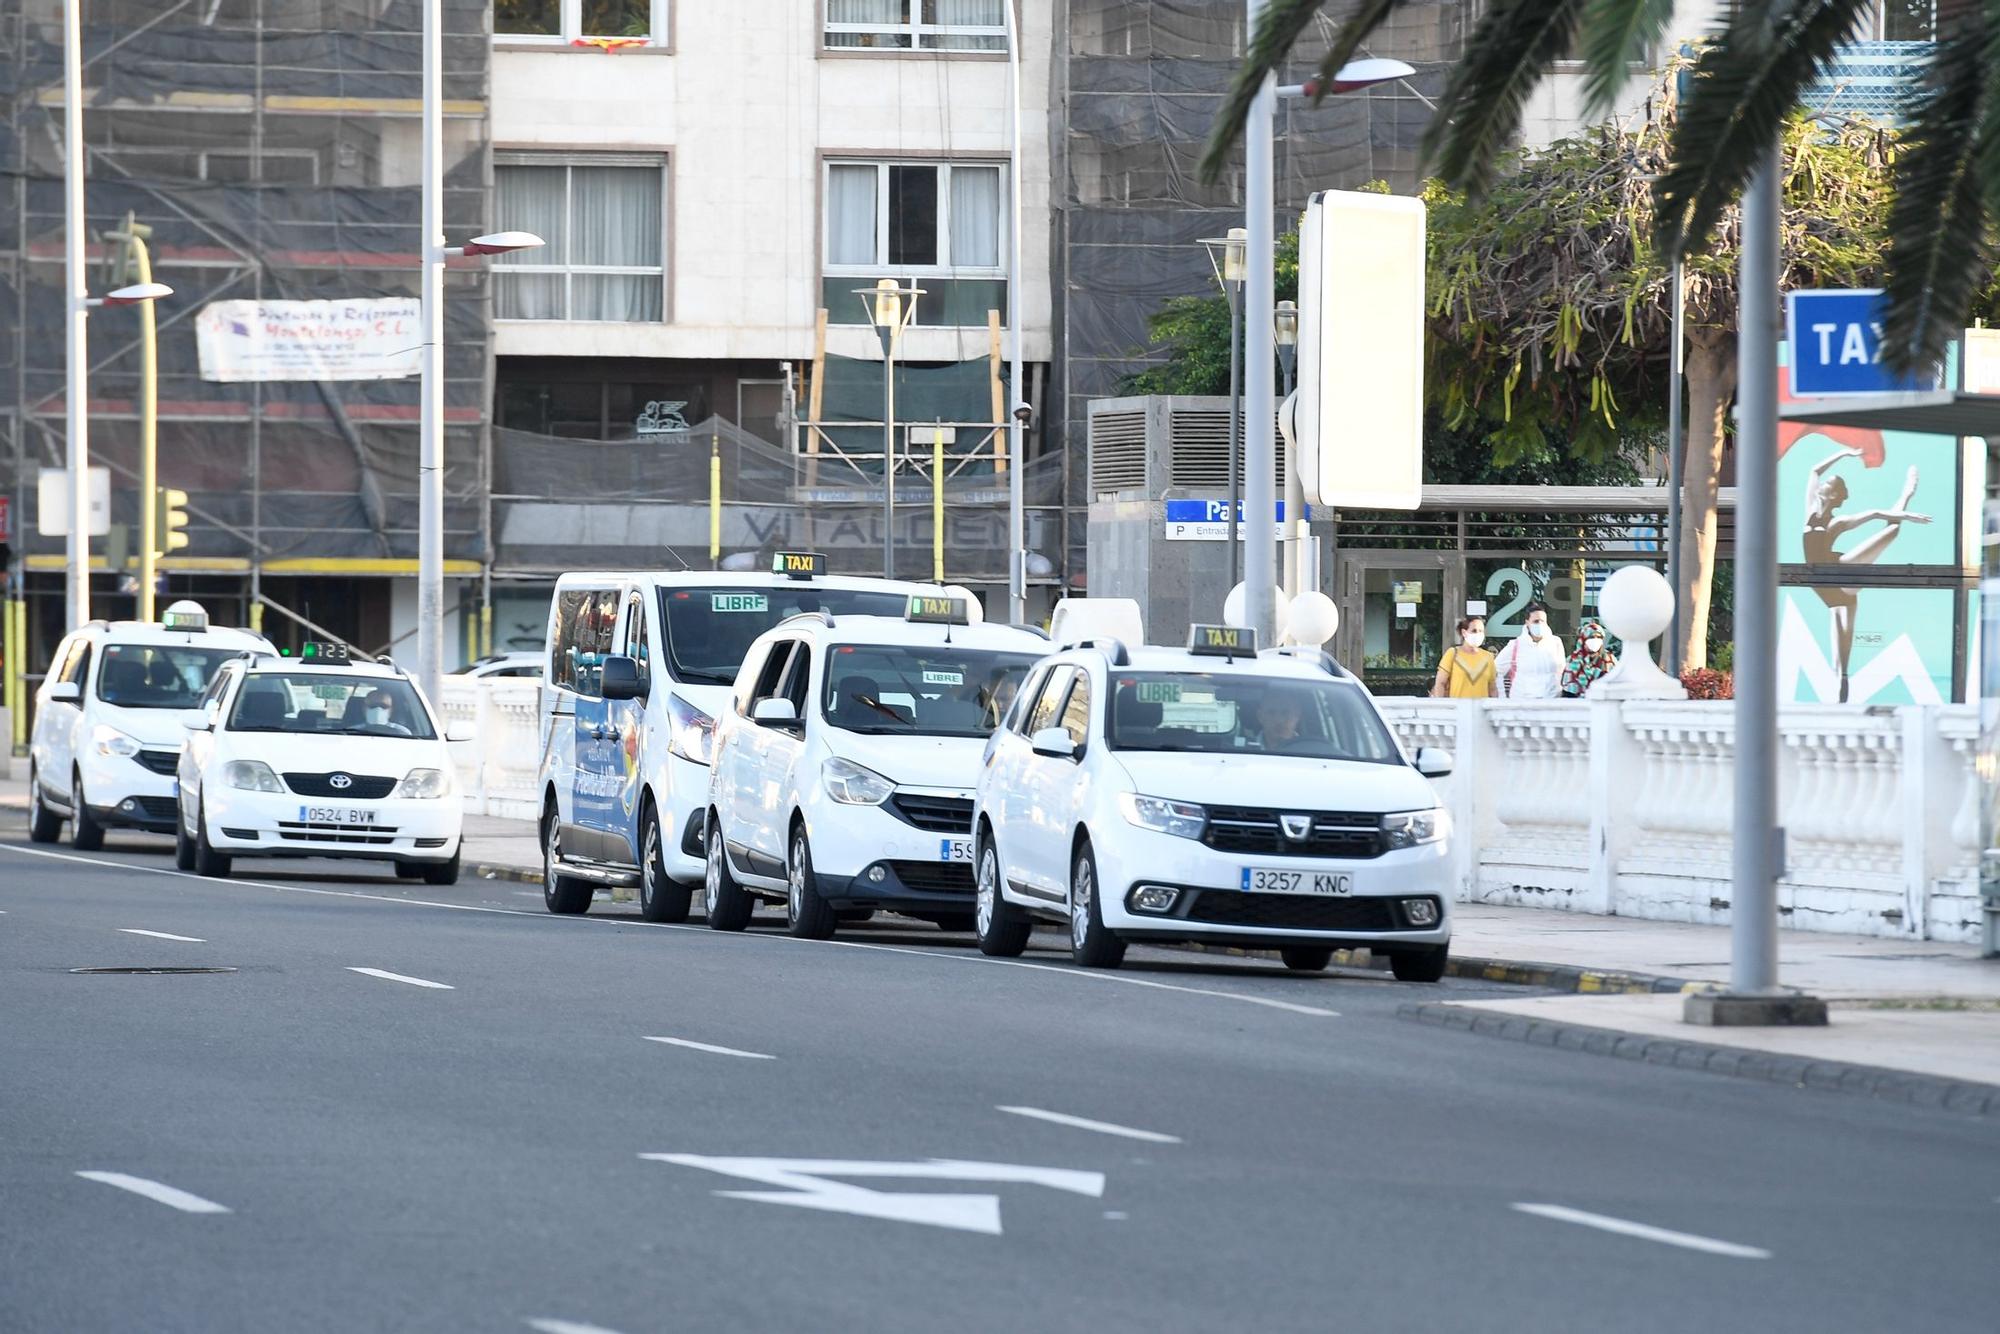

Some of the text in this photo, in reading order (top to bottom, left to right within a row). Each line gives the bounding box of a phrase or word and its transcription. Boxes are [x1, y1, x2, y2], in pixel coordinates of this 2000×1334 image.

[786, 556, 813, 571] TAXI
[923, 599, 951, 614] TAXI
[1486, 568, 1533, 638] 2
[1206, 628, 1238, 646] TAXI
[317, 643, 347, 659] 123
[926, 673, 960, 682] LIBRE
[1139, 683, 1181, 702] LIBRE
[308, 808, 375, 823] 0524 BVW
[1255, 871, 1349, 894] 3257 KNC
